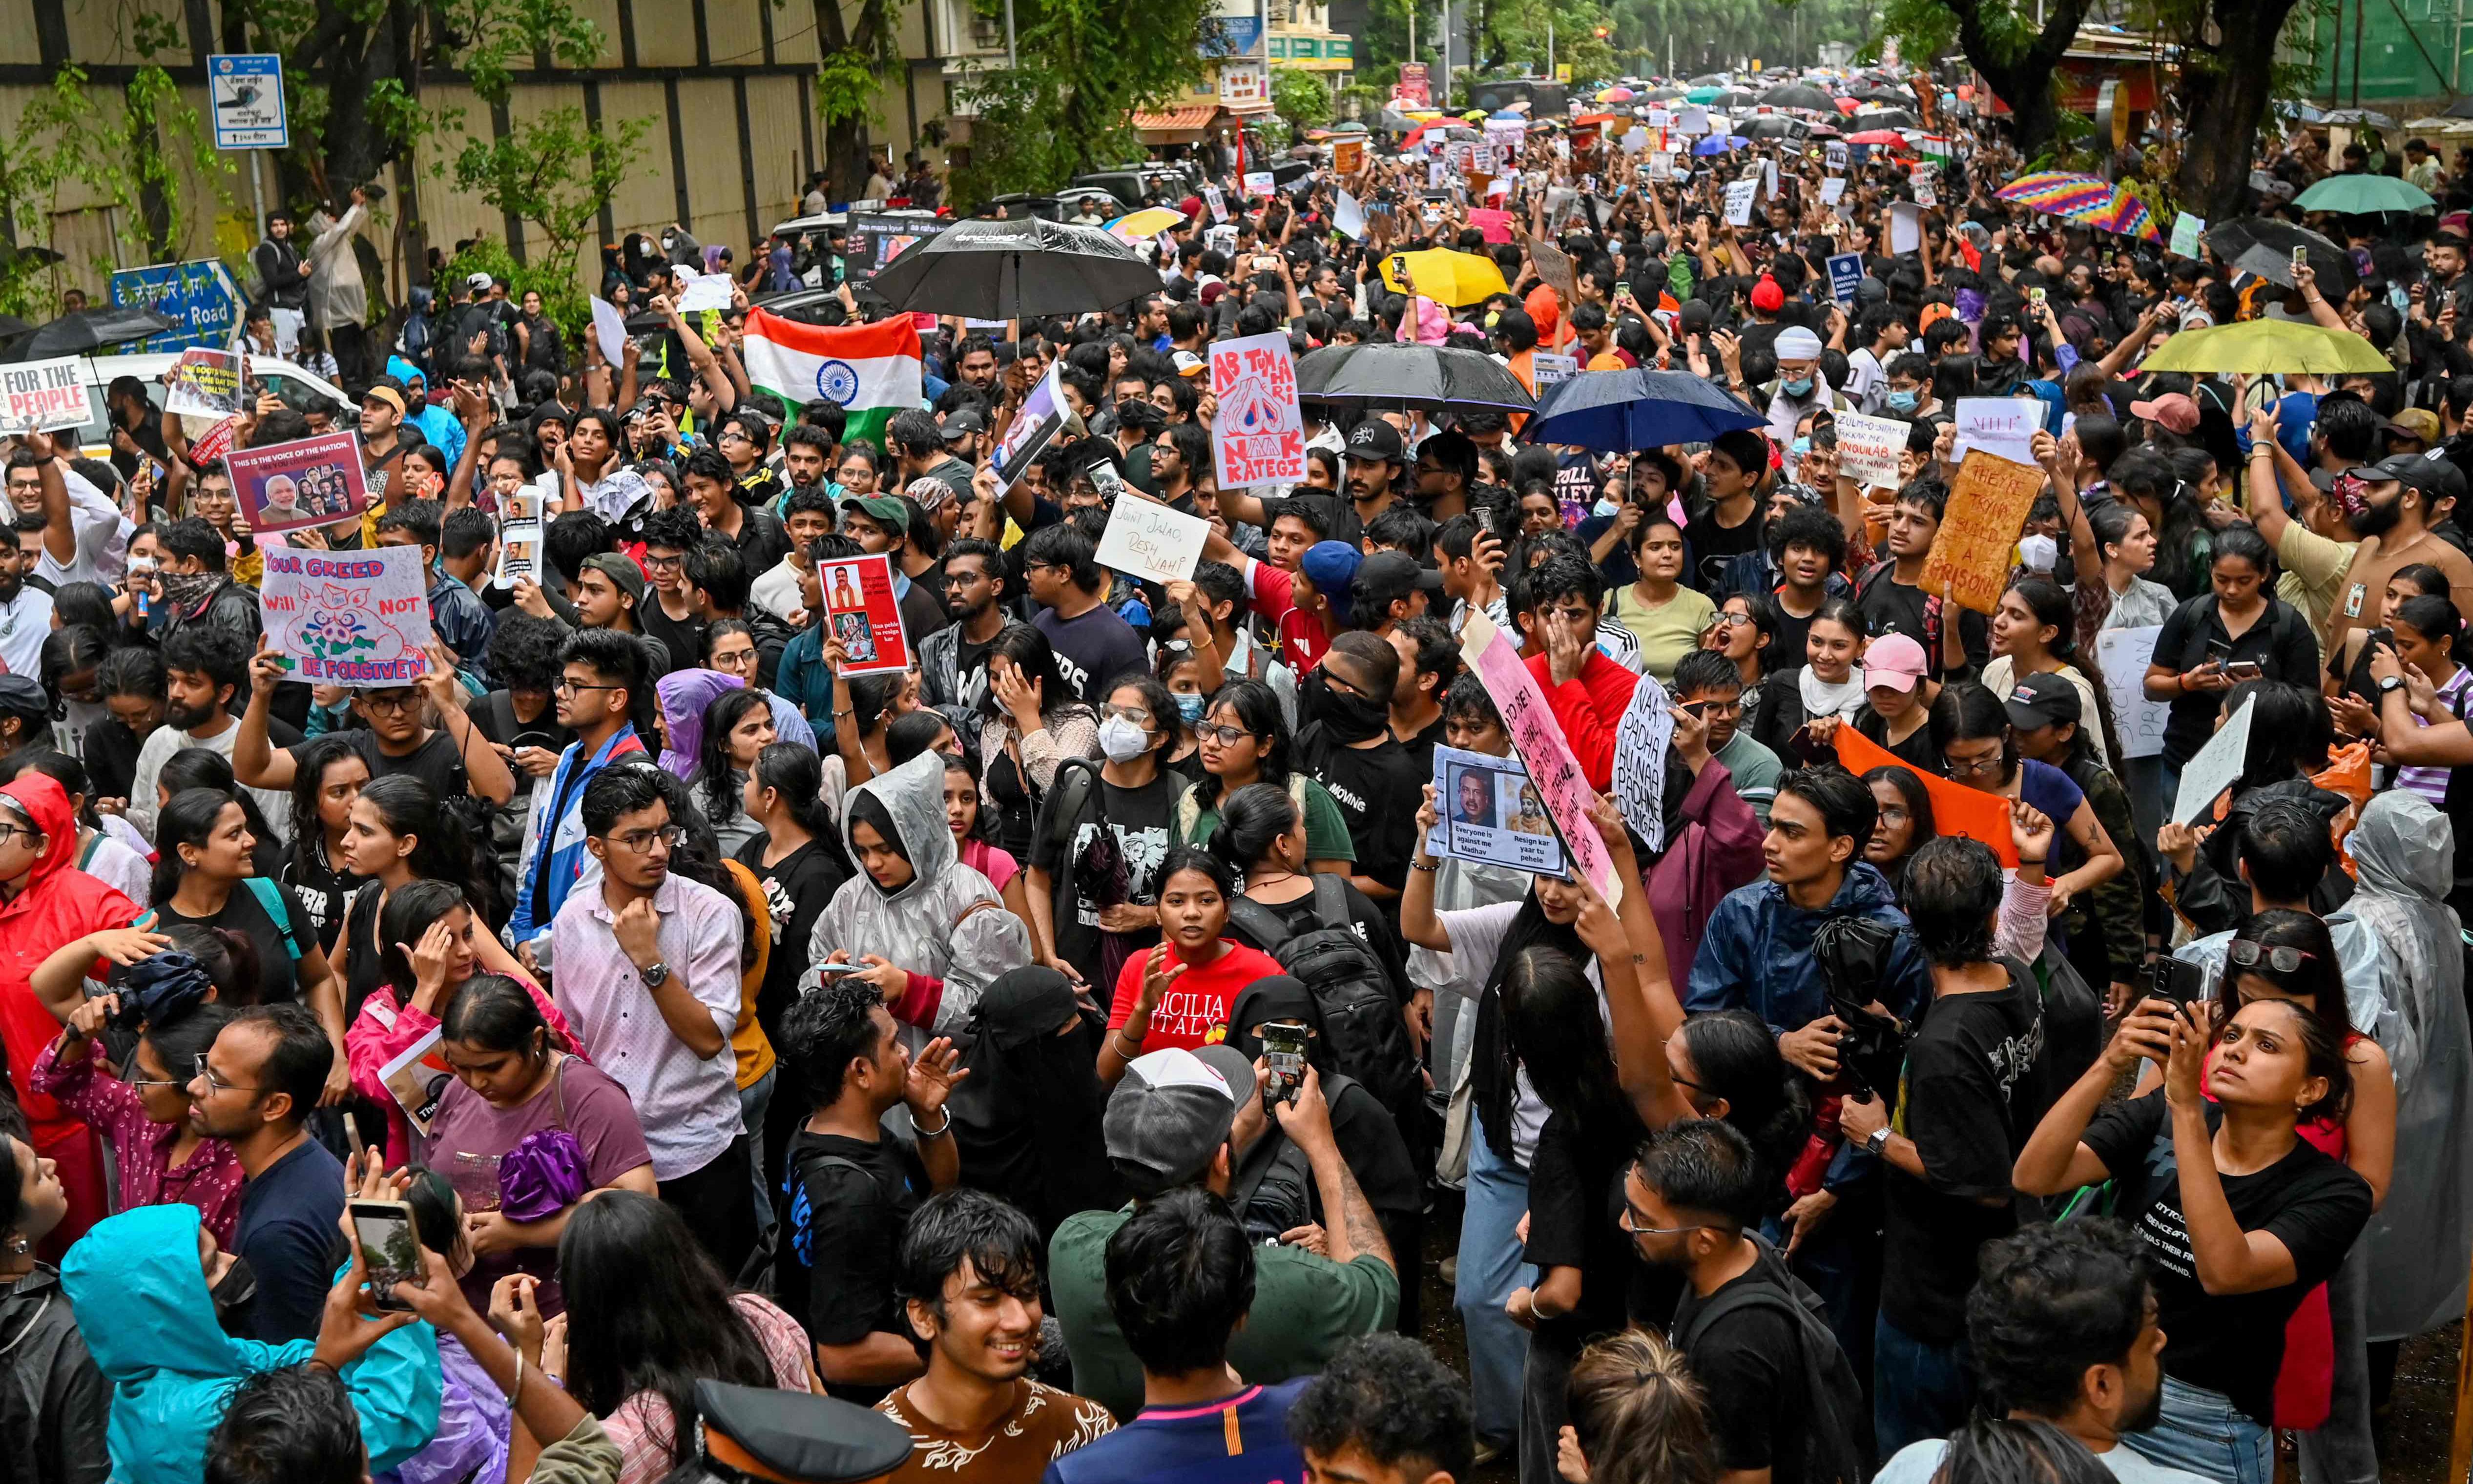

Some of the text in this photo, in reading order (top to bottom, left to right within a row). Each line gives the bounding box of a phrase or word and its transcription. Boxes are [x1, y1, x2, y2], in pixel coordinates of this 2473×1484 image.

[190, 302, 228, 325] Road
[4, 364, 79, 394] FOR THE
[196, 366, 219, 375] BOOTS
[198, 375, 214, 384] ONE
[1214, 351, 1241, 392] AB
[9, 385, 84, 417] PEOPLE
[234, 459, 250, 468] THIS
[258, 455, 272, 464] THE
[272, 451, 294, 462] VOICE
[305, 447, 319, 455] THE
[319, 441, 350, 453] NATION.
[1840, 441, 1890, 458] INQUILAB
[273, 460, 288, 469] YOU
[1226, 457, 1302, 483] KATEGI
[1115, 500, 1143, 524] JOINT
[1955, 517, 1999, 542] BUILD
[1126, 532, 1159, 556] DESH
[1962, 547, 1972, 563] A
[265, 550, 385, 579] YOUR GREED
[378, 597, 421, 616] NOT
[302, 656, 426, 680] BE FORGIVEN
[1622, 711, 1660, 764] PADHA
[1327, 783, 1366, 813] MOVING
[1618, 766, 1660, 823] PADHNE
[1455, 825, 1485, 838] Everyone
[1457, 835, 1480, 847] against
[1514, 835, 1550, 846] Resign kar
[1461, 845, 1487, 855] Madhav
[1520, 846, 1535, 855] yaar
[1149, 1012, 1219, 1036] ITALY
[419, 1102, 438, 1117] The
[2161, 1241, 2182, 1257] THEIR
